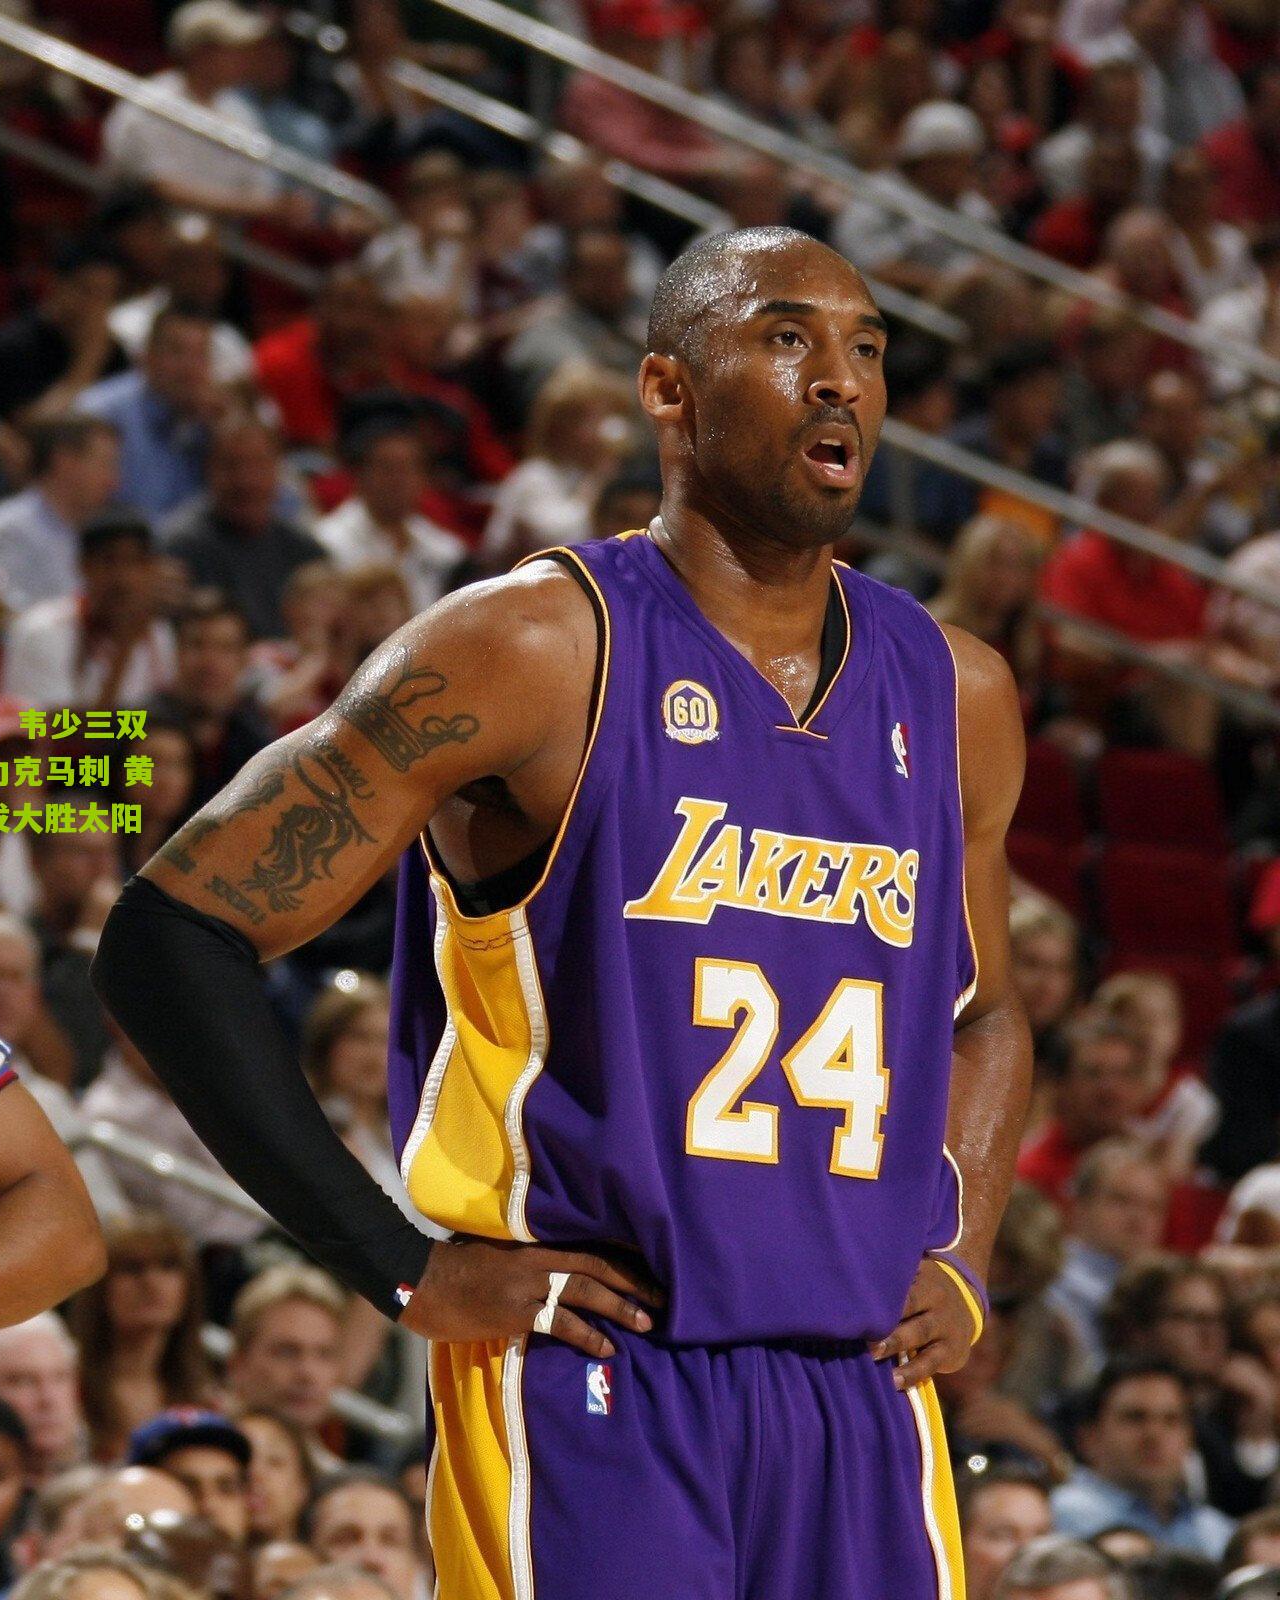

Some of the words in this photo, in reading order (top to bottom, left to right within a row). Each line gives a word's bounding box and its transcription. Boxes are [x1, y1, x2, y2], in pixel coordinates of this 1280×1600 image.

[673, 695, 706, 727] 60
[622, 796, 920, 948] LAKERS
[685, 957, 890, 1180] 24
[588, 1403, 602, 1412] NBA
